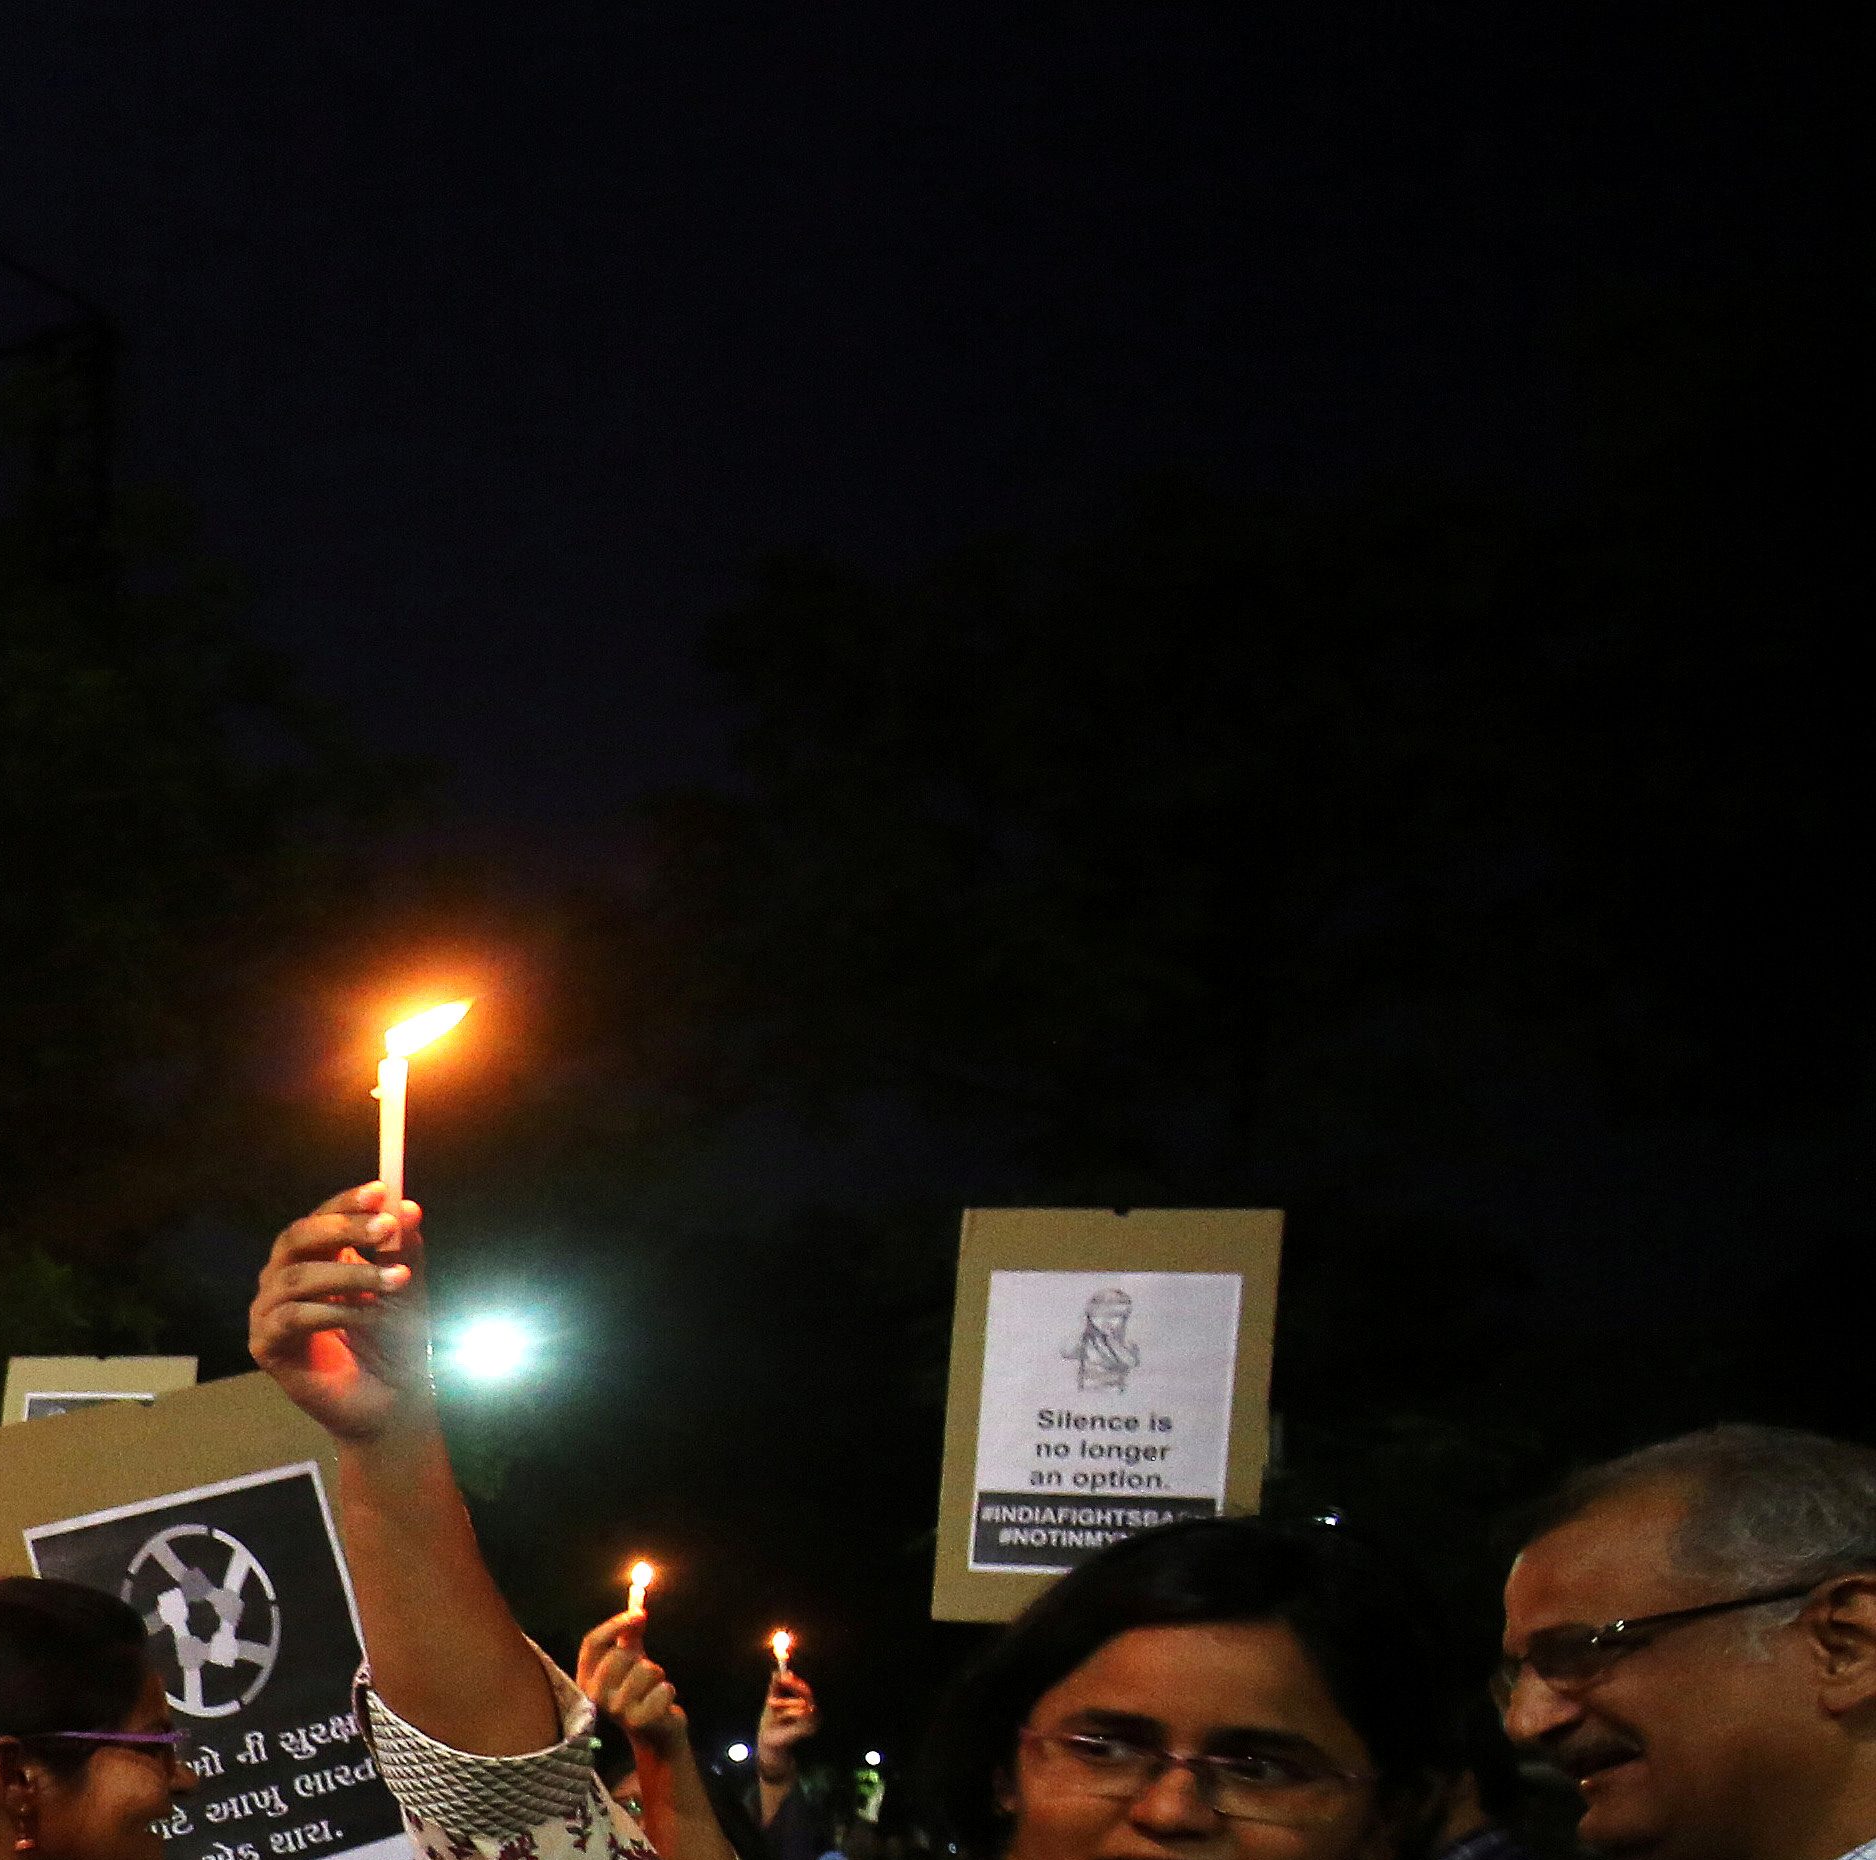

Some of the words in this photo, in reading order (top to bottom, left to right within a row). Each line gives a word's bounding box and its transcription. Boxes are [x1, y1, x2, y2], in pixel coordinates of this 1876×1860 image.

[1038, 1409, 1140, 1432] Silence
[1149, 1411, 1173, 1432] is
[1036, 1442, 1070, 1459] no
[1080, 1440, 1171, 1465] longer
[1030, 1469, 1062, 1487] an
[1073, 1470, 1170, 1492] option.
[980, 1505, 1190, 1527] #INDIAFIGHTSBA
[278, 1712, 360, 1760] સુરક્ષ
[294, 1757, 377, 1797] ભારત
